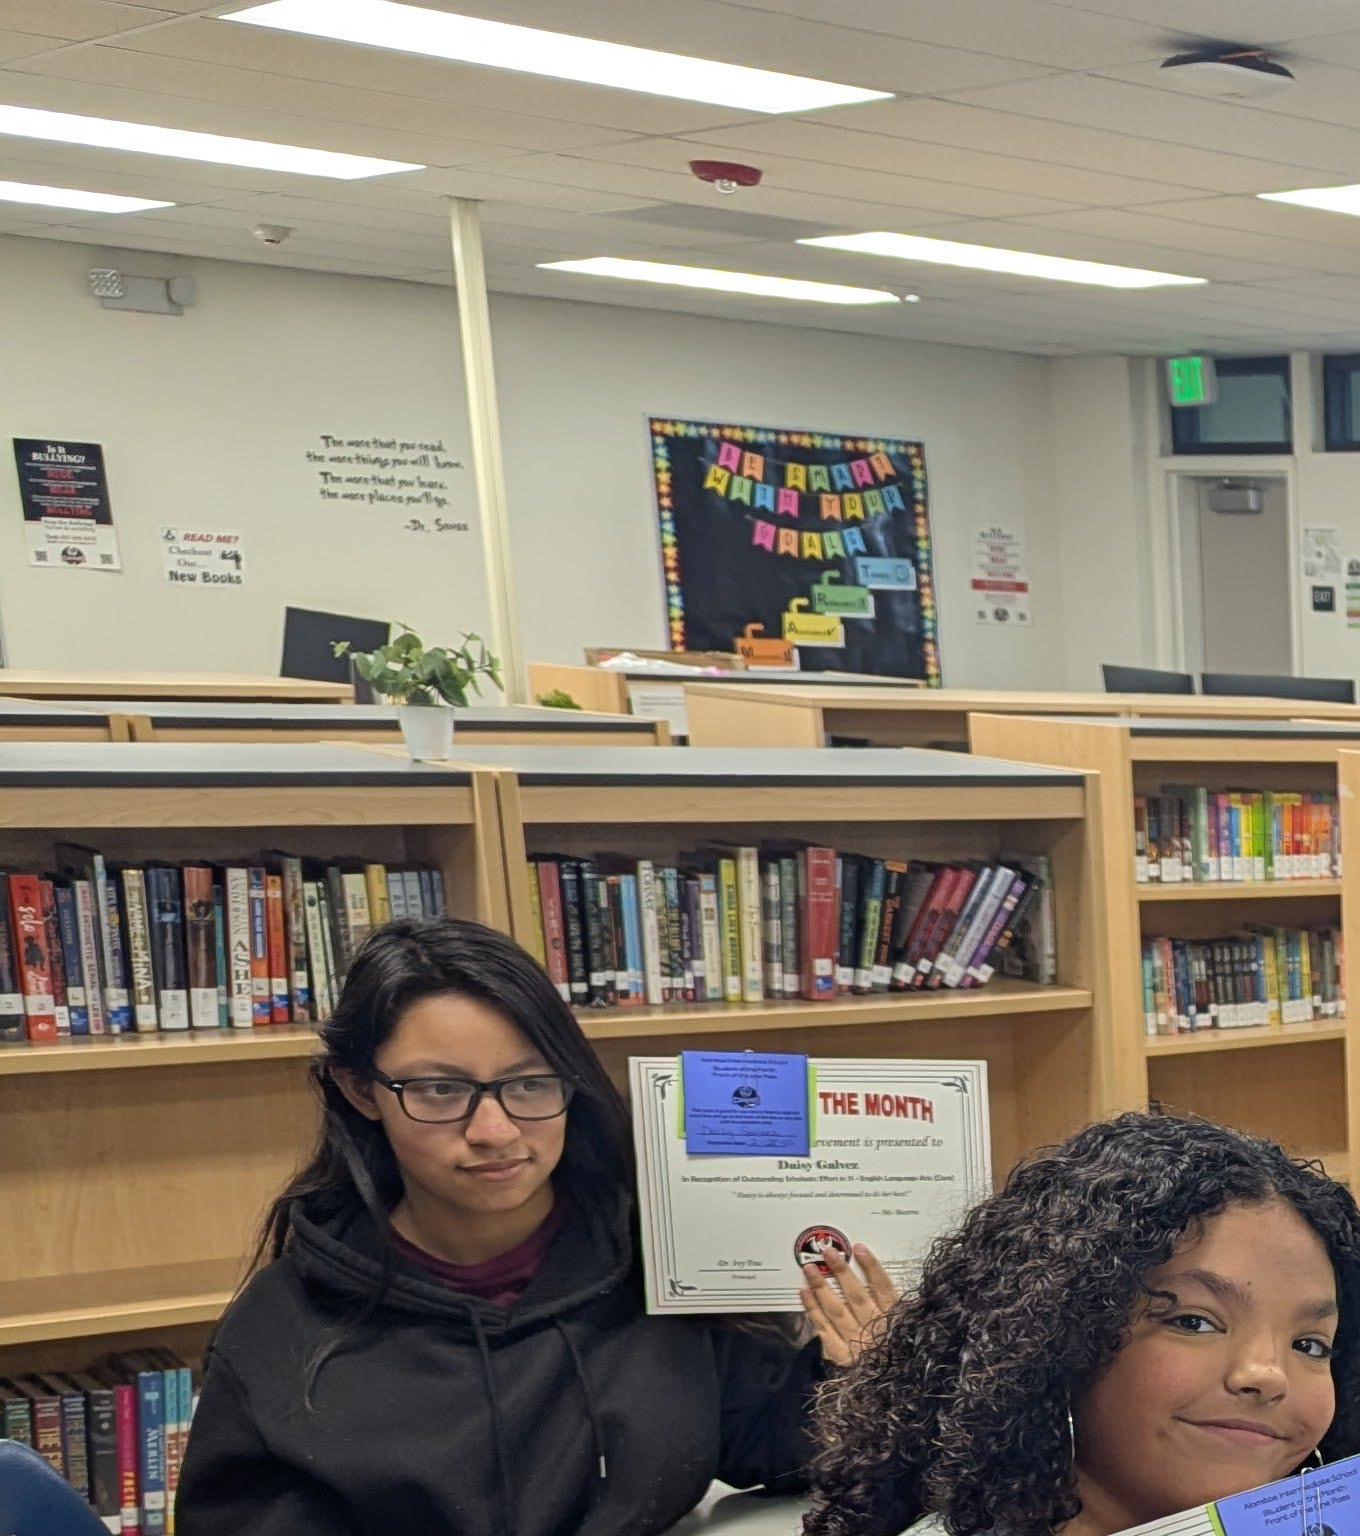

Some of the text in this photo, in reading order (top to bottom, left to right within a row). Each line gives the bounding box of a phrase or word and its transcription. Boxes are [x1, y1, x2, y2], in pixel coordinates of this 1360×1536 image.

[32, 452, 85, 463] BULLYING?
[184, 533, 239, 543] READ ME?
[169, 570, 242, 584] New Books
[818, 1092, 934, 1123] THE MONTH
[864, 1136, 943, 1150] is presented to
[778, 1159, 859, 1172] Daisy Galvez
[146, 1427, 160, 1481] MERLIN
